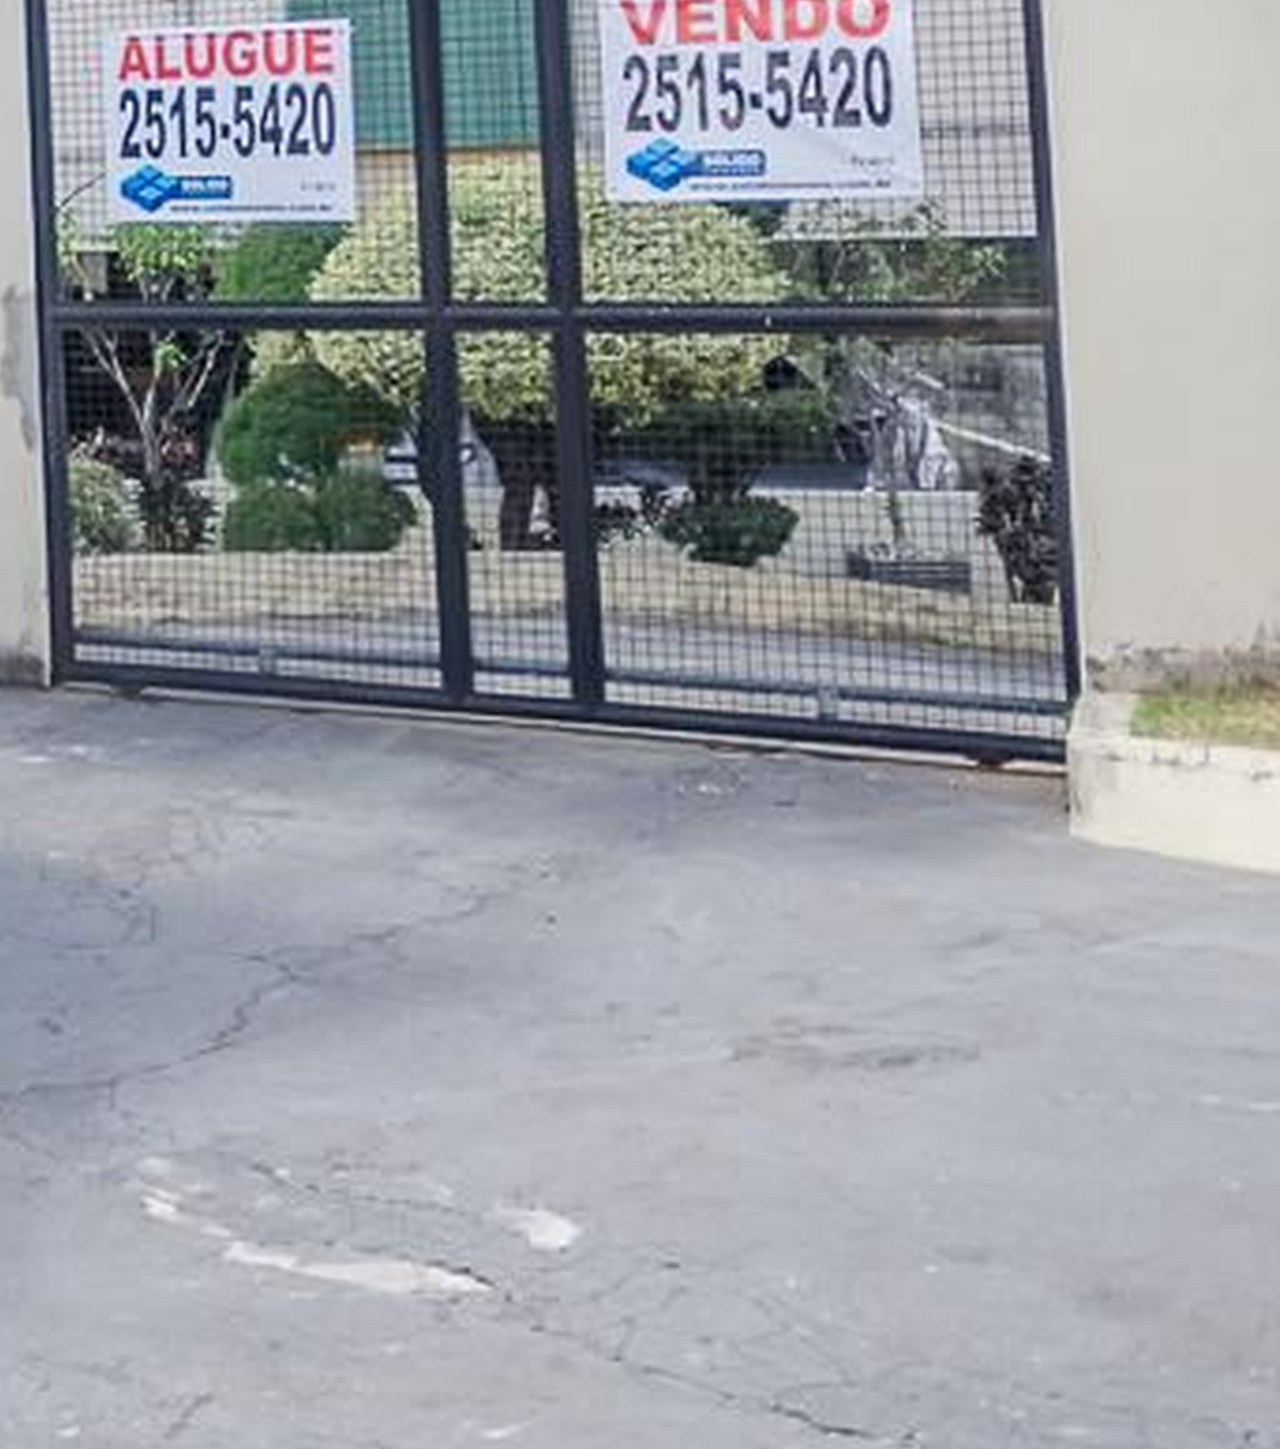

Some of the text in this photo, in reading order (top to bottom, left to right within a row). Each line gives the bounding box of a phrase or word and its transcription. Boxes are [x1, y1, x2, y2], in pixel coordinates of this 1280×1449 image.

[118, 28, 336, 80] ALUGUE
[622, 46, 893, 133] 2515-5420
[119, 81, 336, 159] 2515-5420
